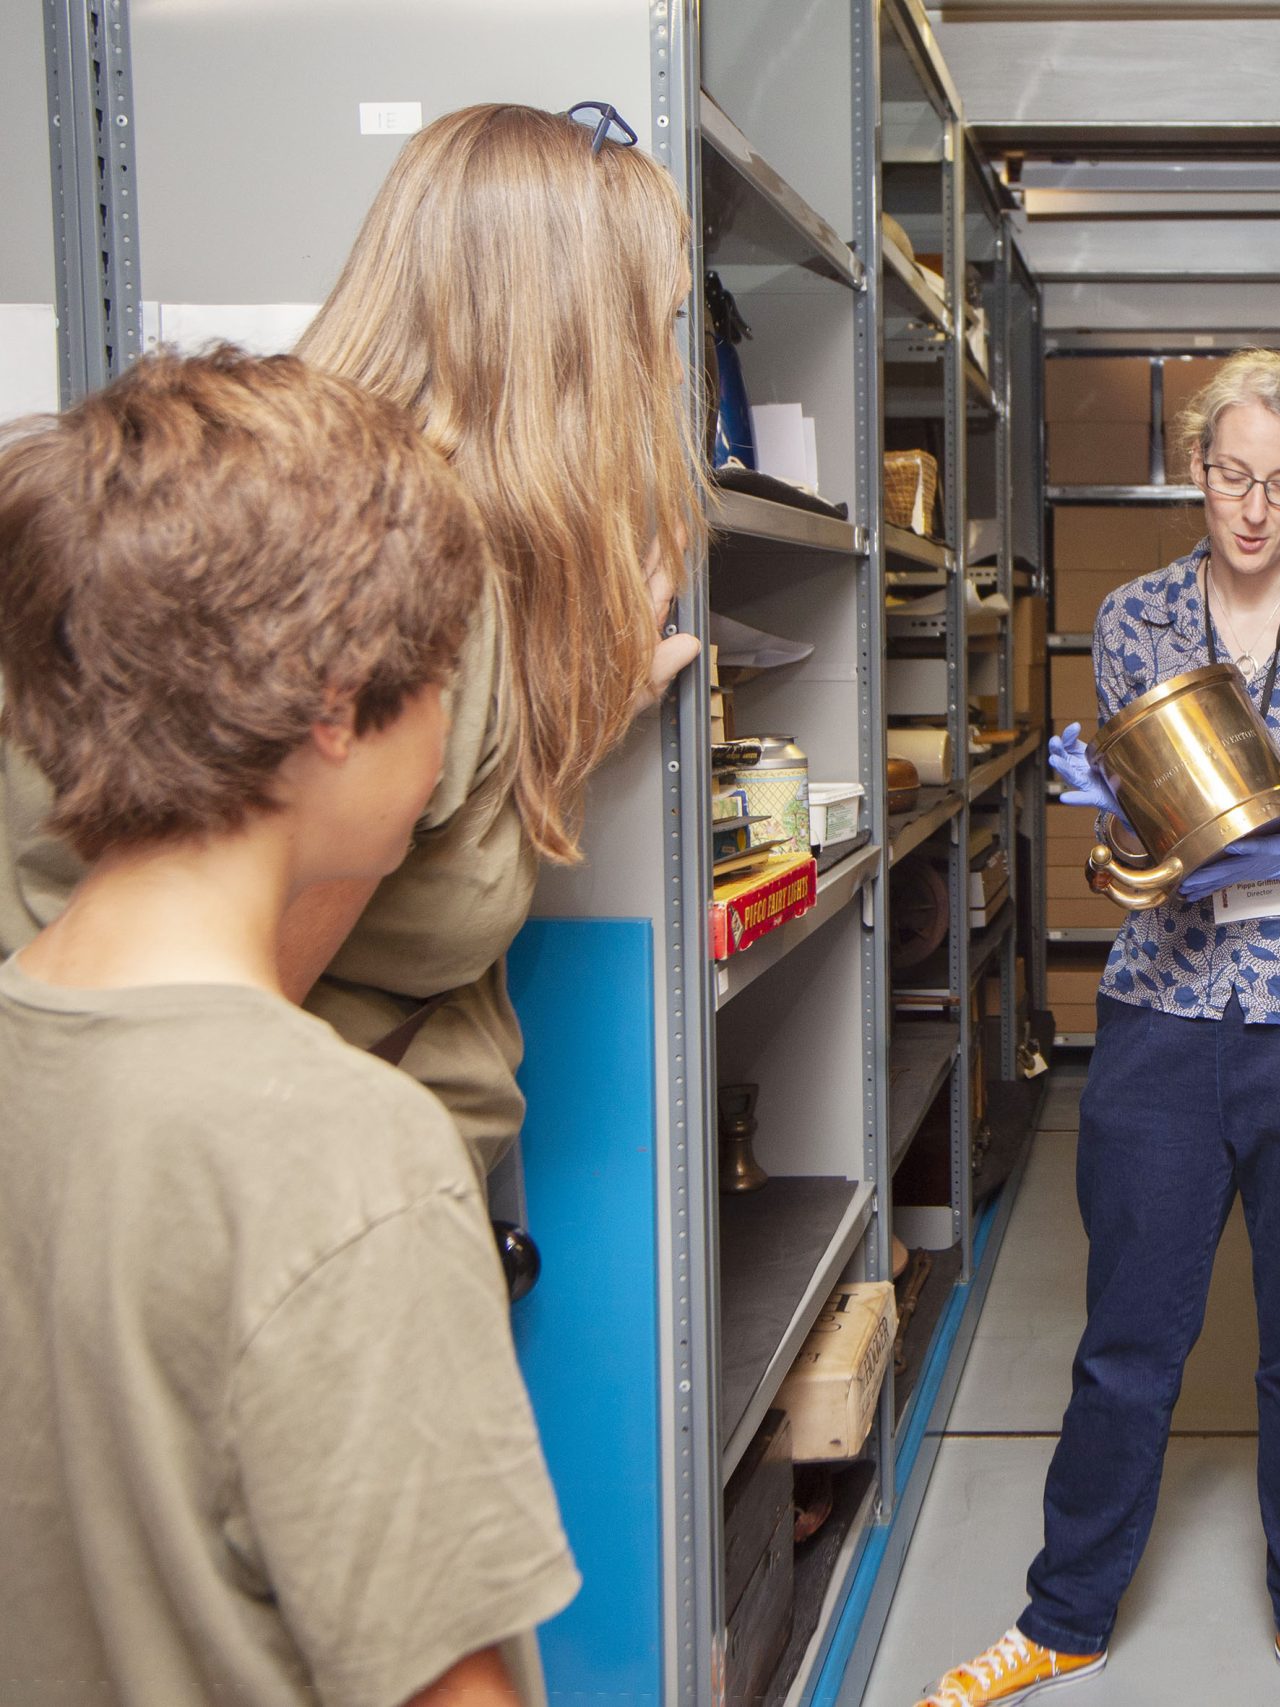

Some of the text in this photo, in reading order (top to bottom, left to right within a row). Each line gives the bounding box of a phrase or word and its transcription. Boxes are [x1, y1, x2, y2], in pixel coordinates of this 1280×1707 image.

[744, 897, 767, 931] PIFCO
[767, 886, 788, 918] FAIRY
[787, 875, 808, 907] LIGHTS
[1246, 889, 1273, 898] Director
